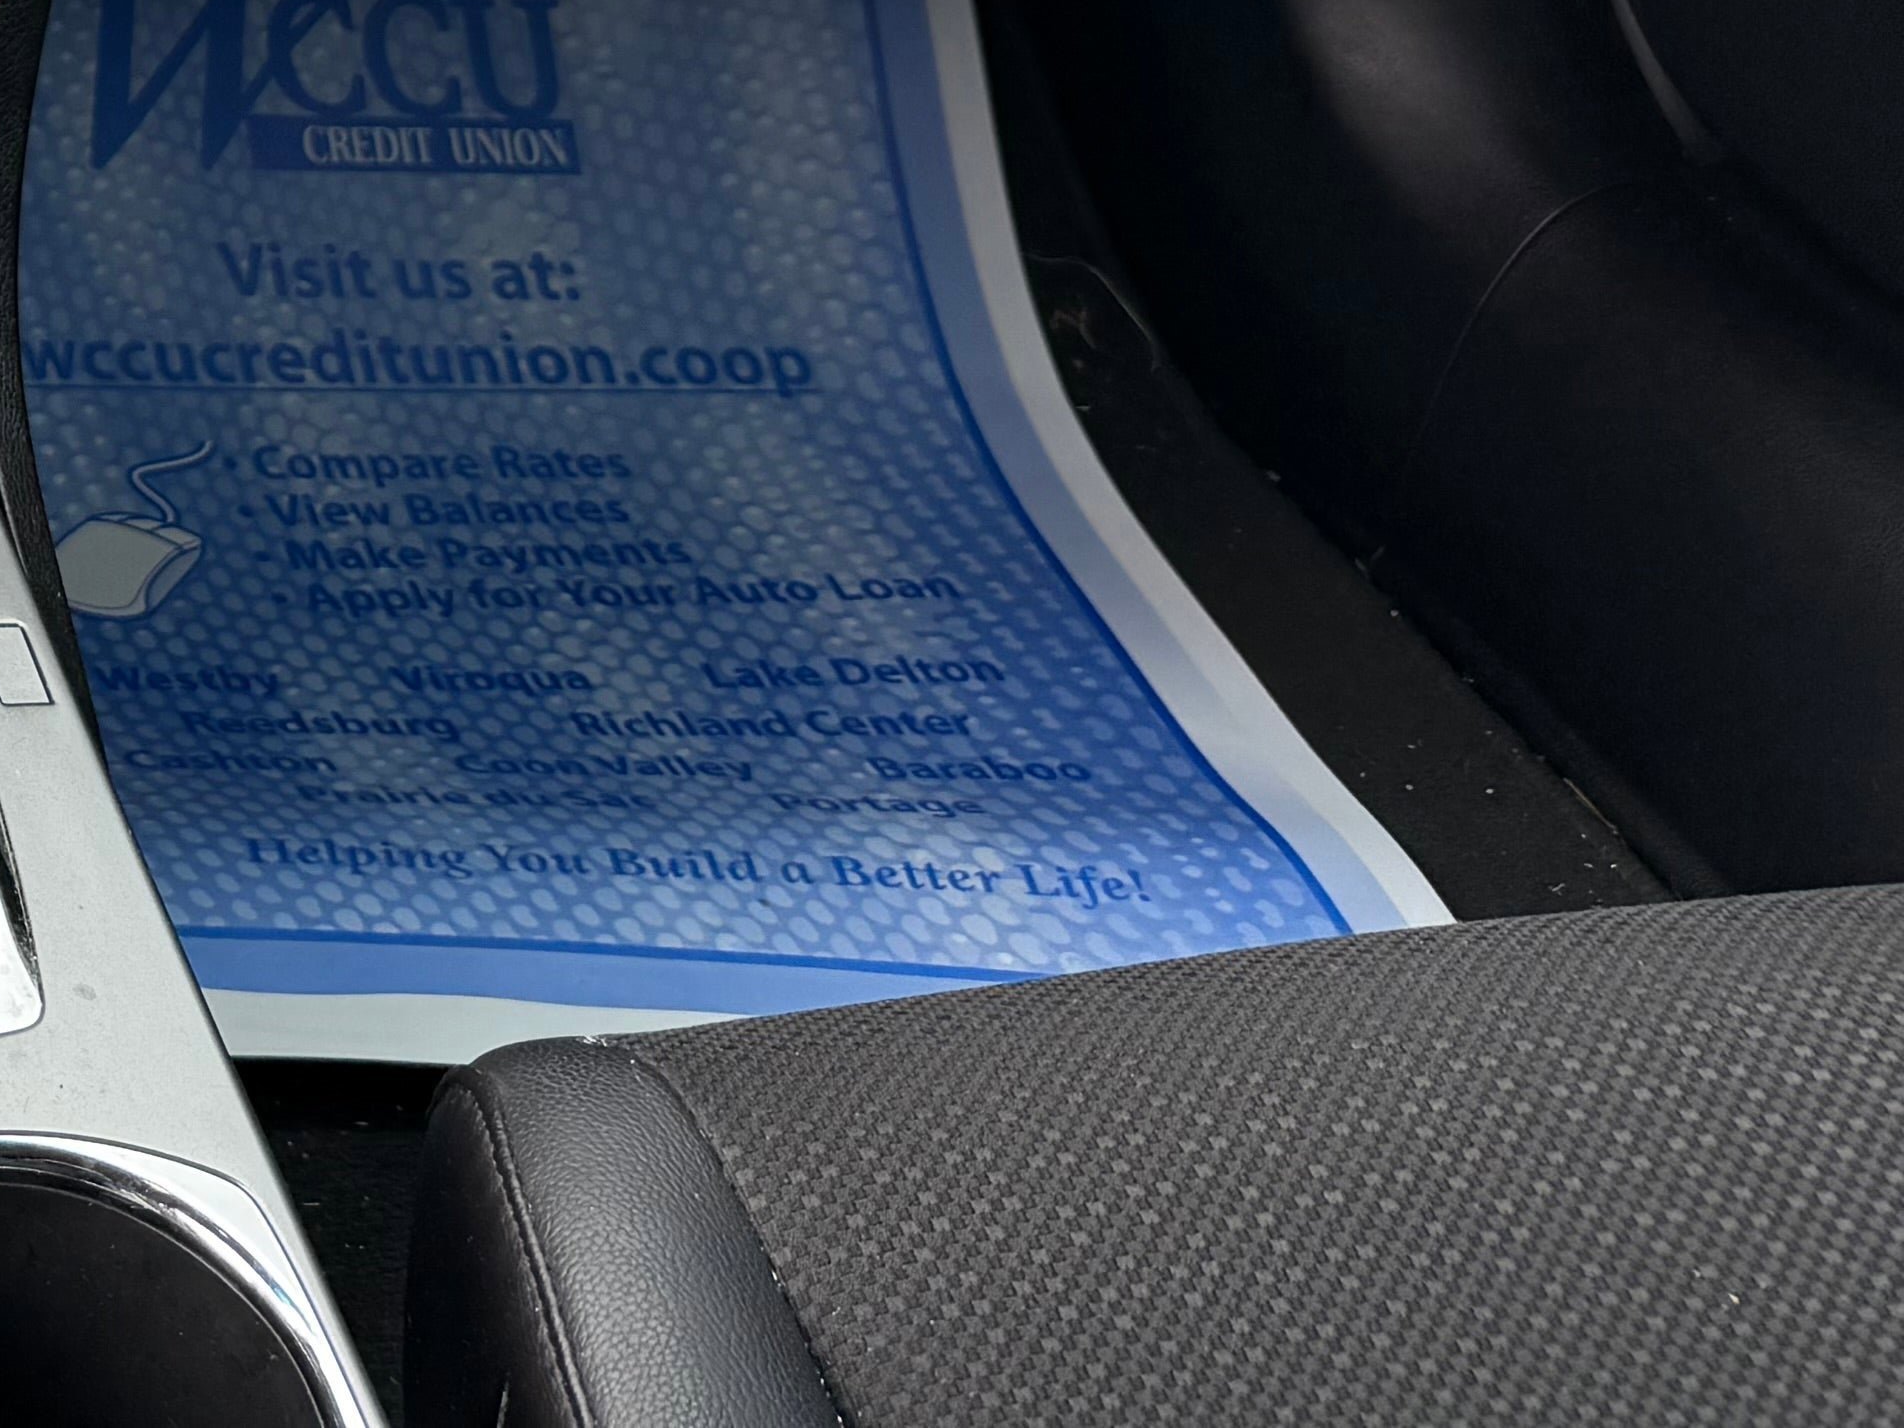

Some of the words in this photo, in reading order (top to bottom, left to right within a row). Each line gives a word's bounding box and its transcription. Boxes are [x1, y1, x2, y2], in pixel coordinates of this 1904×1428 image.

[301, 123, 433, 167] CREDIT
[449, 127, 570, 168] UNION
[214, 243, 376, 299] Visit
[399, 258, 472, 301] us
[493, 251, 582, 302] at:
[24, 328, 813, 397] wccucreditunion.coop
[253, 445, 482, 487] Compare
[493, 444, 632, 479] Rates
[264, 492, 392, 527] View
[405, 491, 631, 526] Balances
[285, 539, 429, 571] Make
[440, 536, 692, 574] Payments
[307, 580, 455, 619] Apply
[468, 577, 541, 610] for
[555, 577, 676, 609] Your
[694, 574, 820, 605] Auto
[824, 572, 961, 602] Loan
[91, 664, 279, 699] Westby
[391, 663, 594, 702] Viroqua
[698, 658, 825, 691] Lake
[827, 653, 1006, 688] Delton
[179, 710, 462, 742] Reedsburg
[569, 708, 793, 740] Richland
[804, 707, 973, 740] Center
[123, 749, 339, 774] Cashton
[453, 751, 591, 776] Coon
[594, 753, 754, 783] Valley
[866, 756, 1092, 784] Baraboo
[298, 785, 480, 806] Prairie
[483, 786, 555, 807] du
[563, 787, 659, 811] Sac
[770, 791, 987, 818] Portage
[244, 837, 474, 880] Helping
[480, 842, 593, 875] You
[604, 846, 761, 885] Build
[780, 858, 817, 886] a
[827, 853, 998, 894] Better
[1012, 862, 1154, 910] Life!
